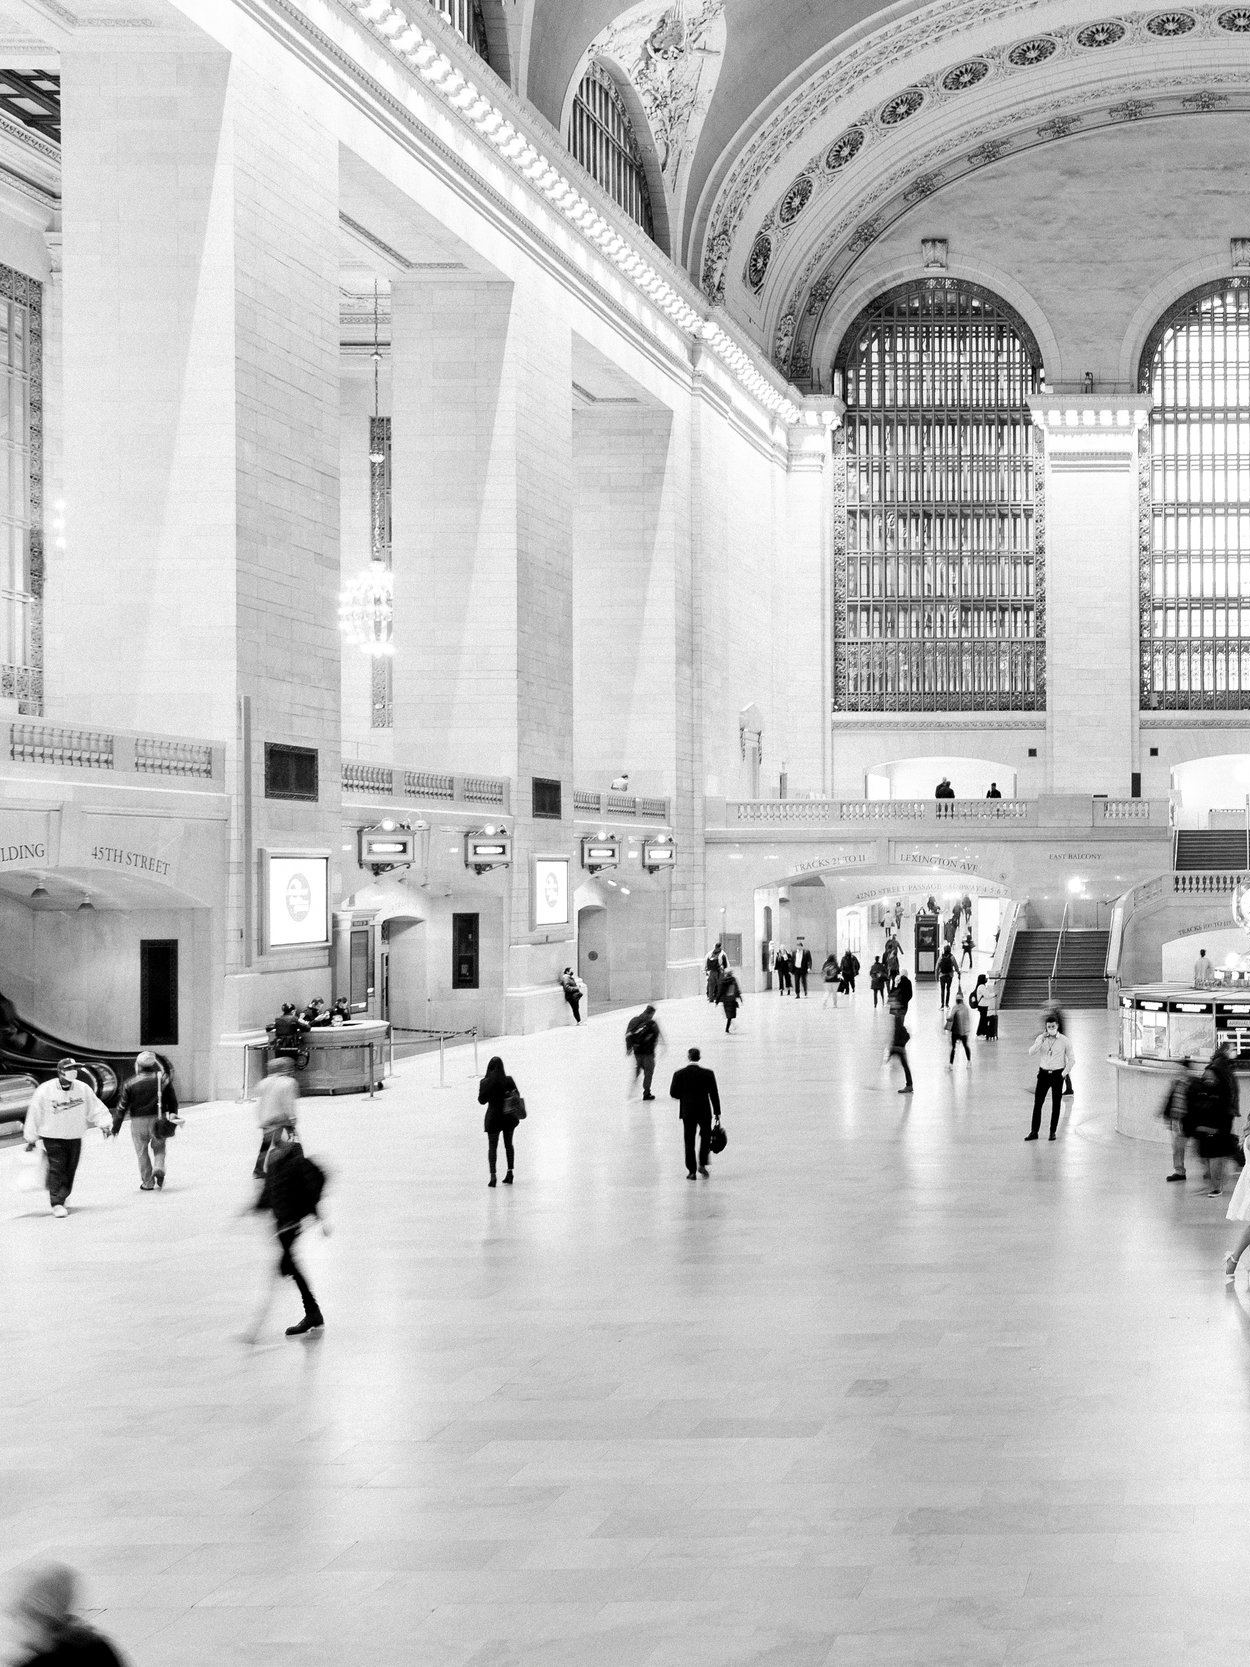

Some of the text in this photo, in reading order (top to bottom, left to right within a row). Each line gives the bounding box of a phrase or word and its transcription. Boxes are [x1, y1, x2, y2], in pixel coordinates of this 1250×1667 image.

[91, 846, 170, 876] 45TH STREET
[793, 859, 830, 872] TRACKS
[843, 855, 857, 863] TO
[900, 853, 979, 872] LEXINGTON AVE
[878, 885, 905, 895] STREET
[1178, 925, 1202, 936] TRACKS
